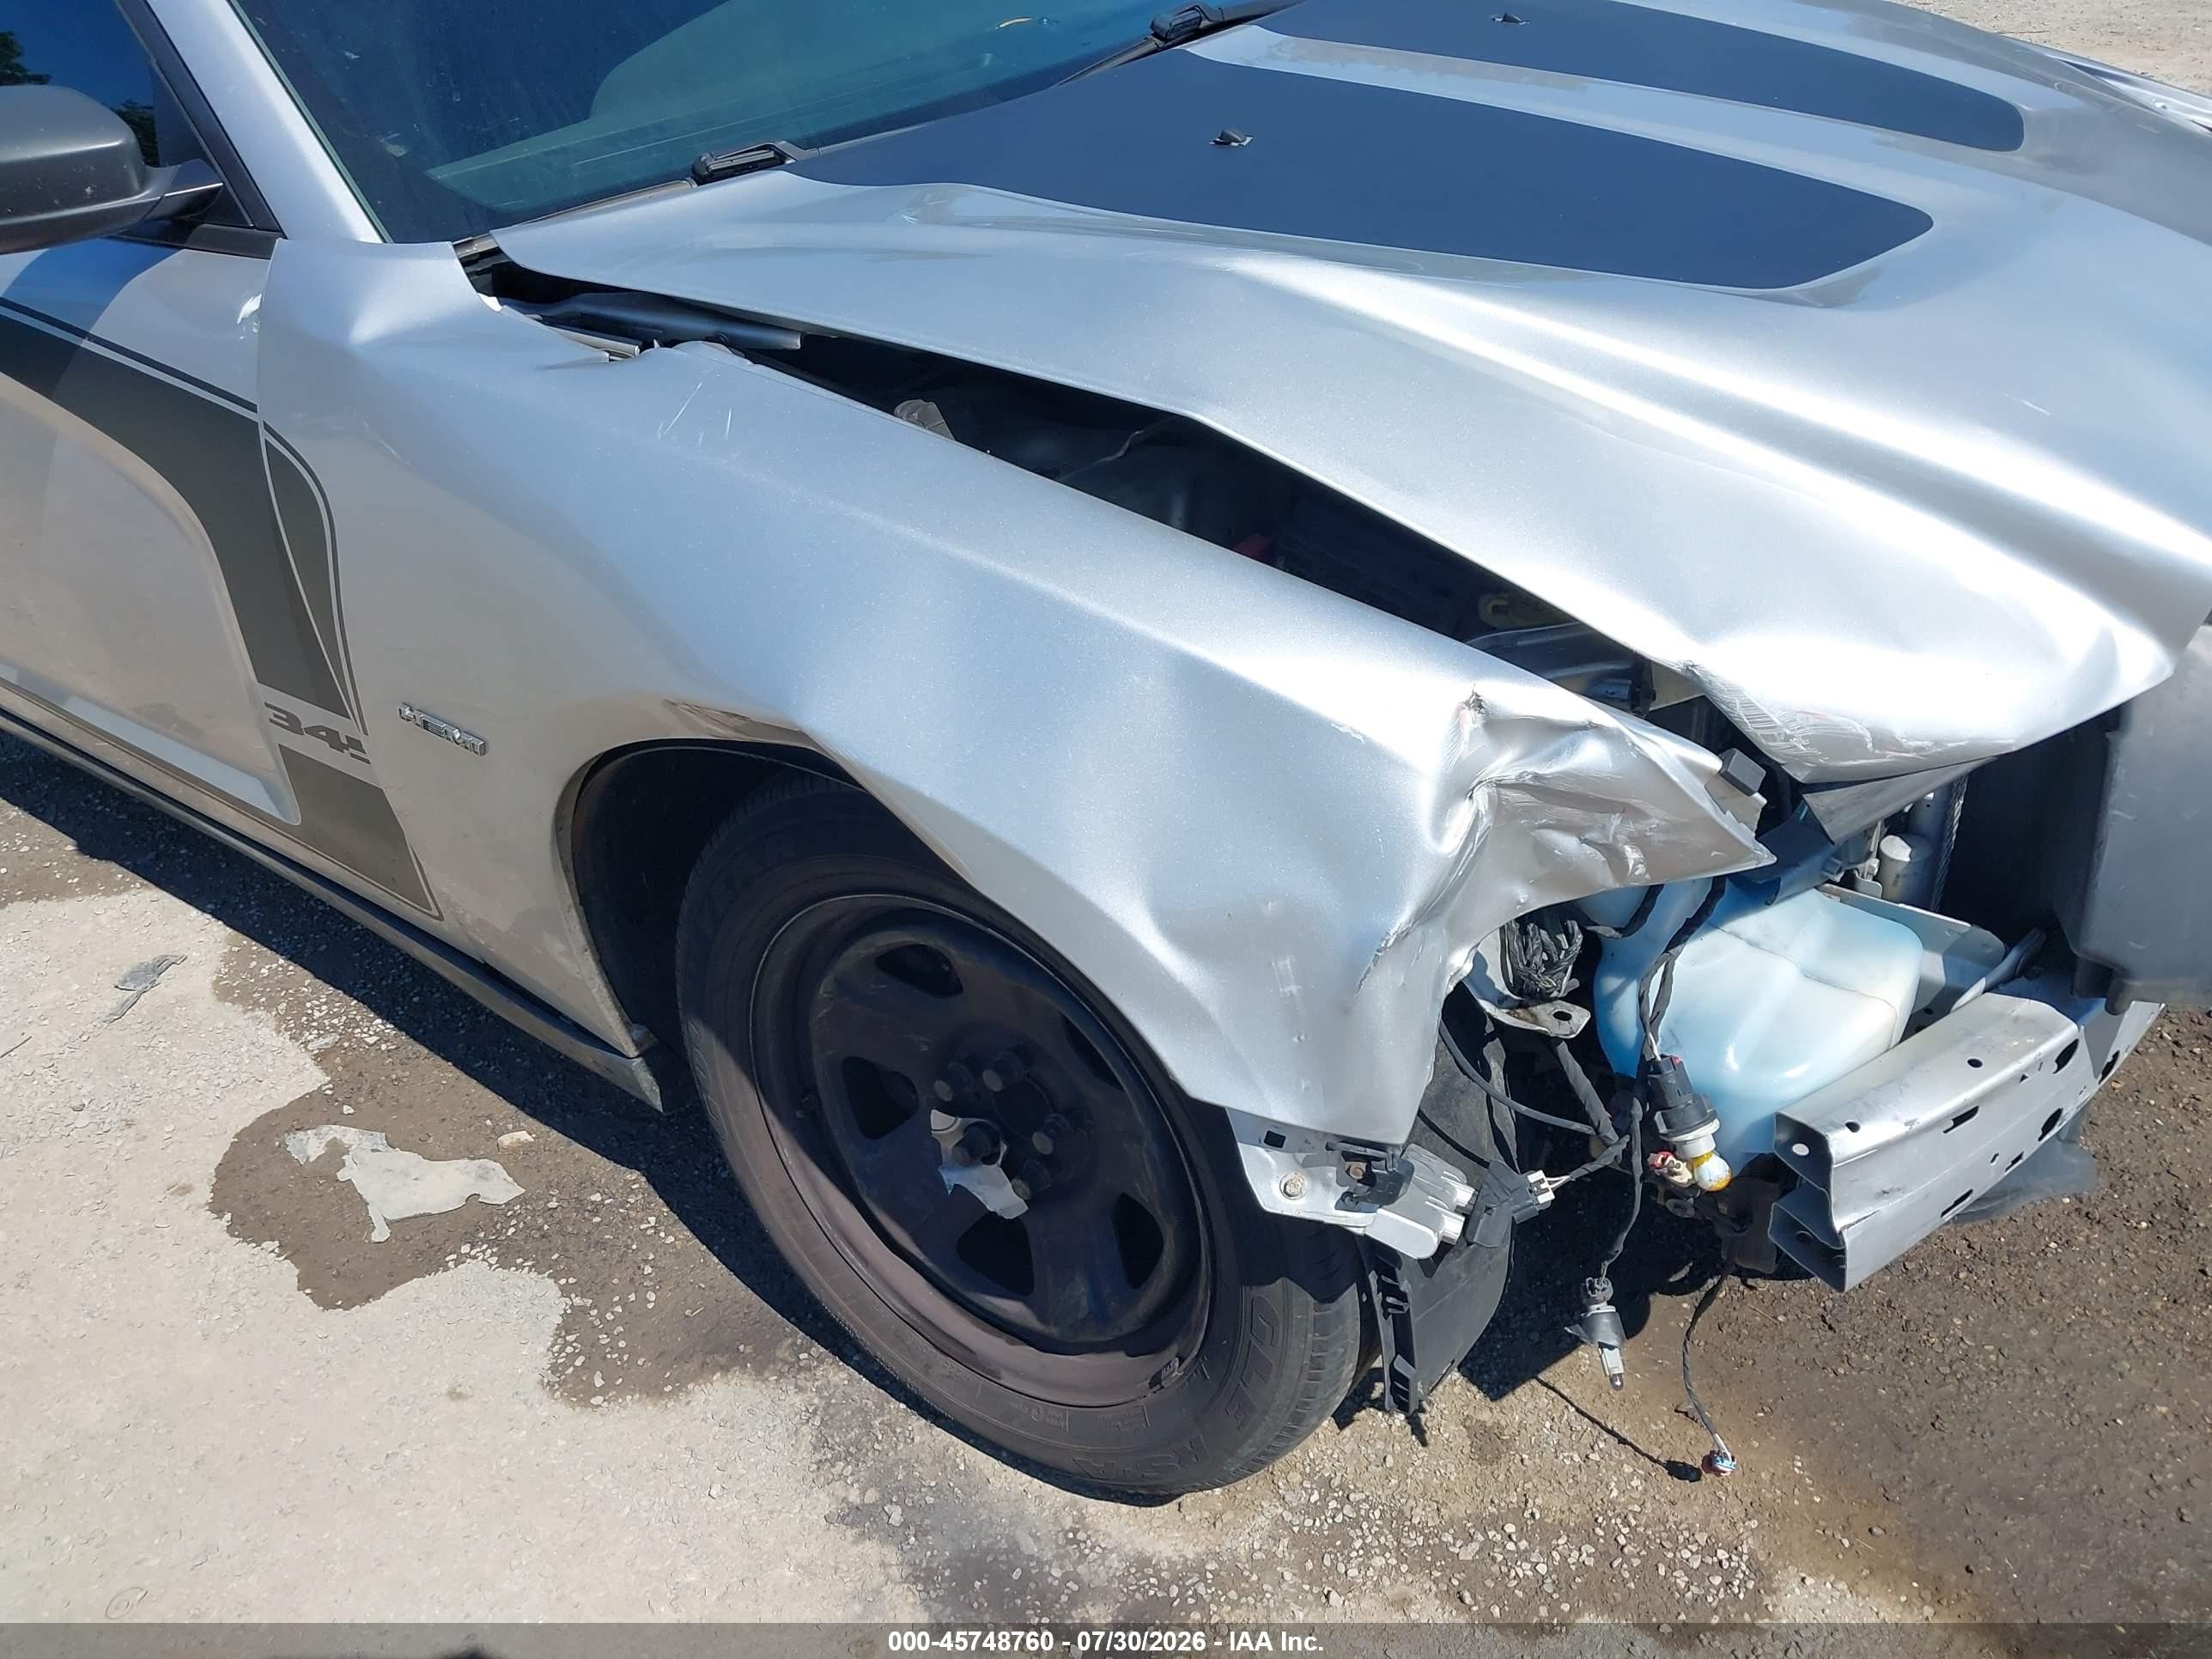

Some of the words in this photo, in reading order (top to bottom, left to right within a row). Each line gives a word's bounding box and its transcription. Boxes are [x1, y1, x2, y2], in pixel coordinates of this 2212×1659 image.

[264, 702, 371, 764] 345
[398, 702, 487, 756] HEMI
[1226, 1295, 1281, 1431] GLE
